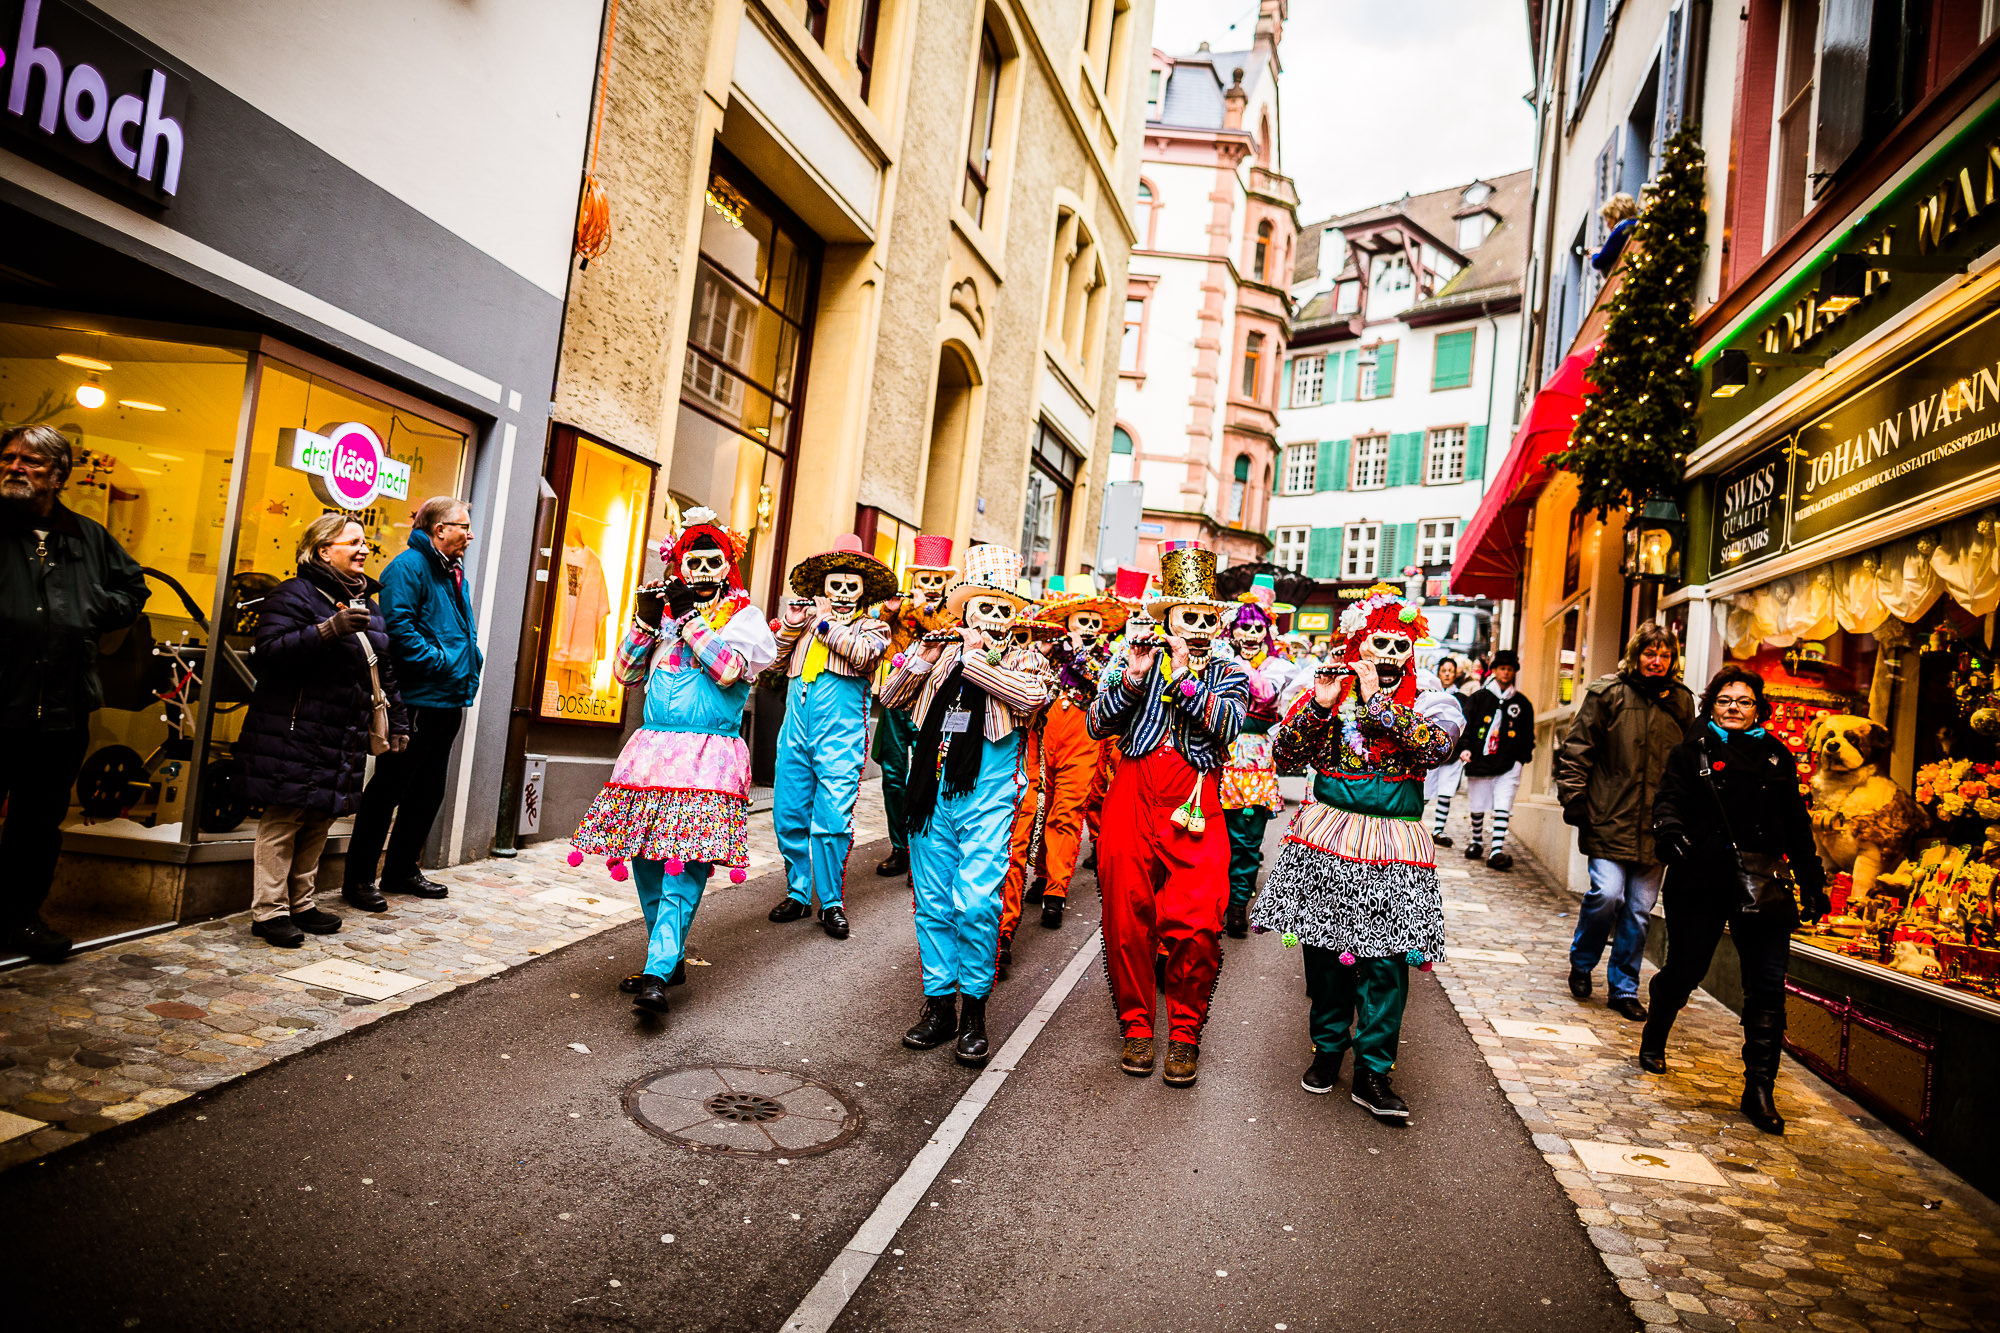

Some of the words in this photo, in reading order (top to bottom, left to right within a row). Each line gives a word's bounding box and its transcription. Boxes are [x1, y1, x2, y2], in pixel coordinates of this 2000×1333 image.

[8, 0, 184, 197] hoch
[302, 441, 332, 471] drei
[334, 444, 375, 486] käse
[377, 461, 407, 495] hoch
[1794, 421, 2000, 522] WEIHNACHTSBAUMSCHMUCKAUSSTATTUNGSSPEZIAL
[1806, 412, 1903, 493] JOHANN
[1723, 462, 1775, 518] SWISS
[1720, 527, 1769, 564] SOUVENIRS
[1722, 499, 1771, 541] QUALITY
[556, 694, 607, 716] DOSSIER
